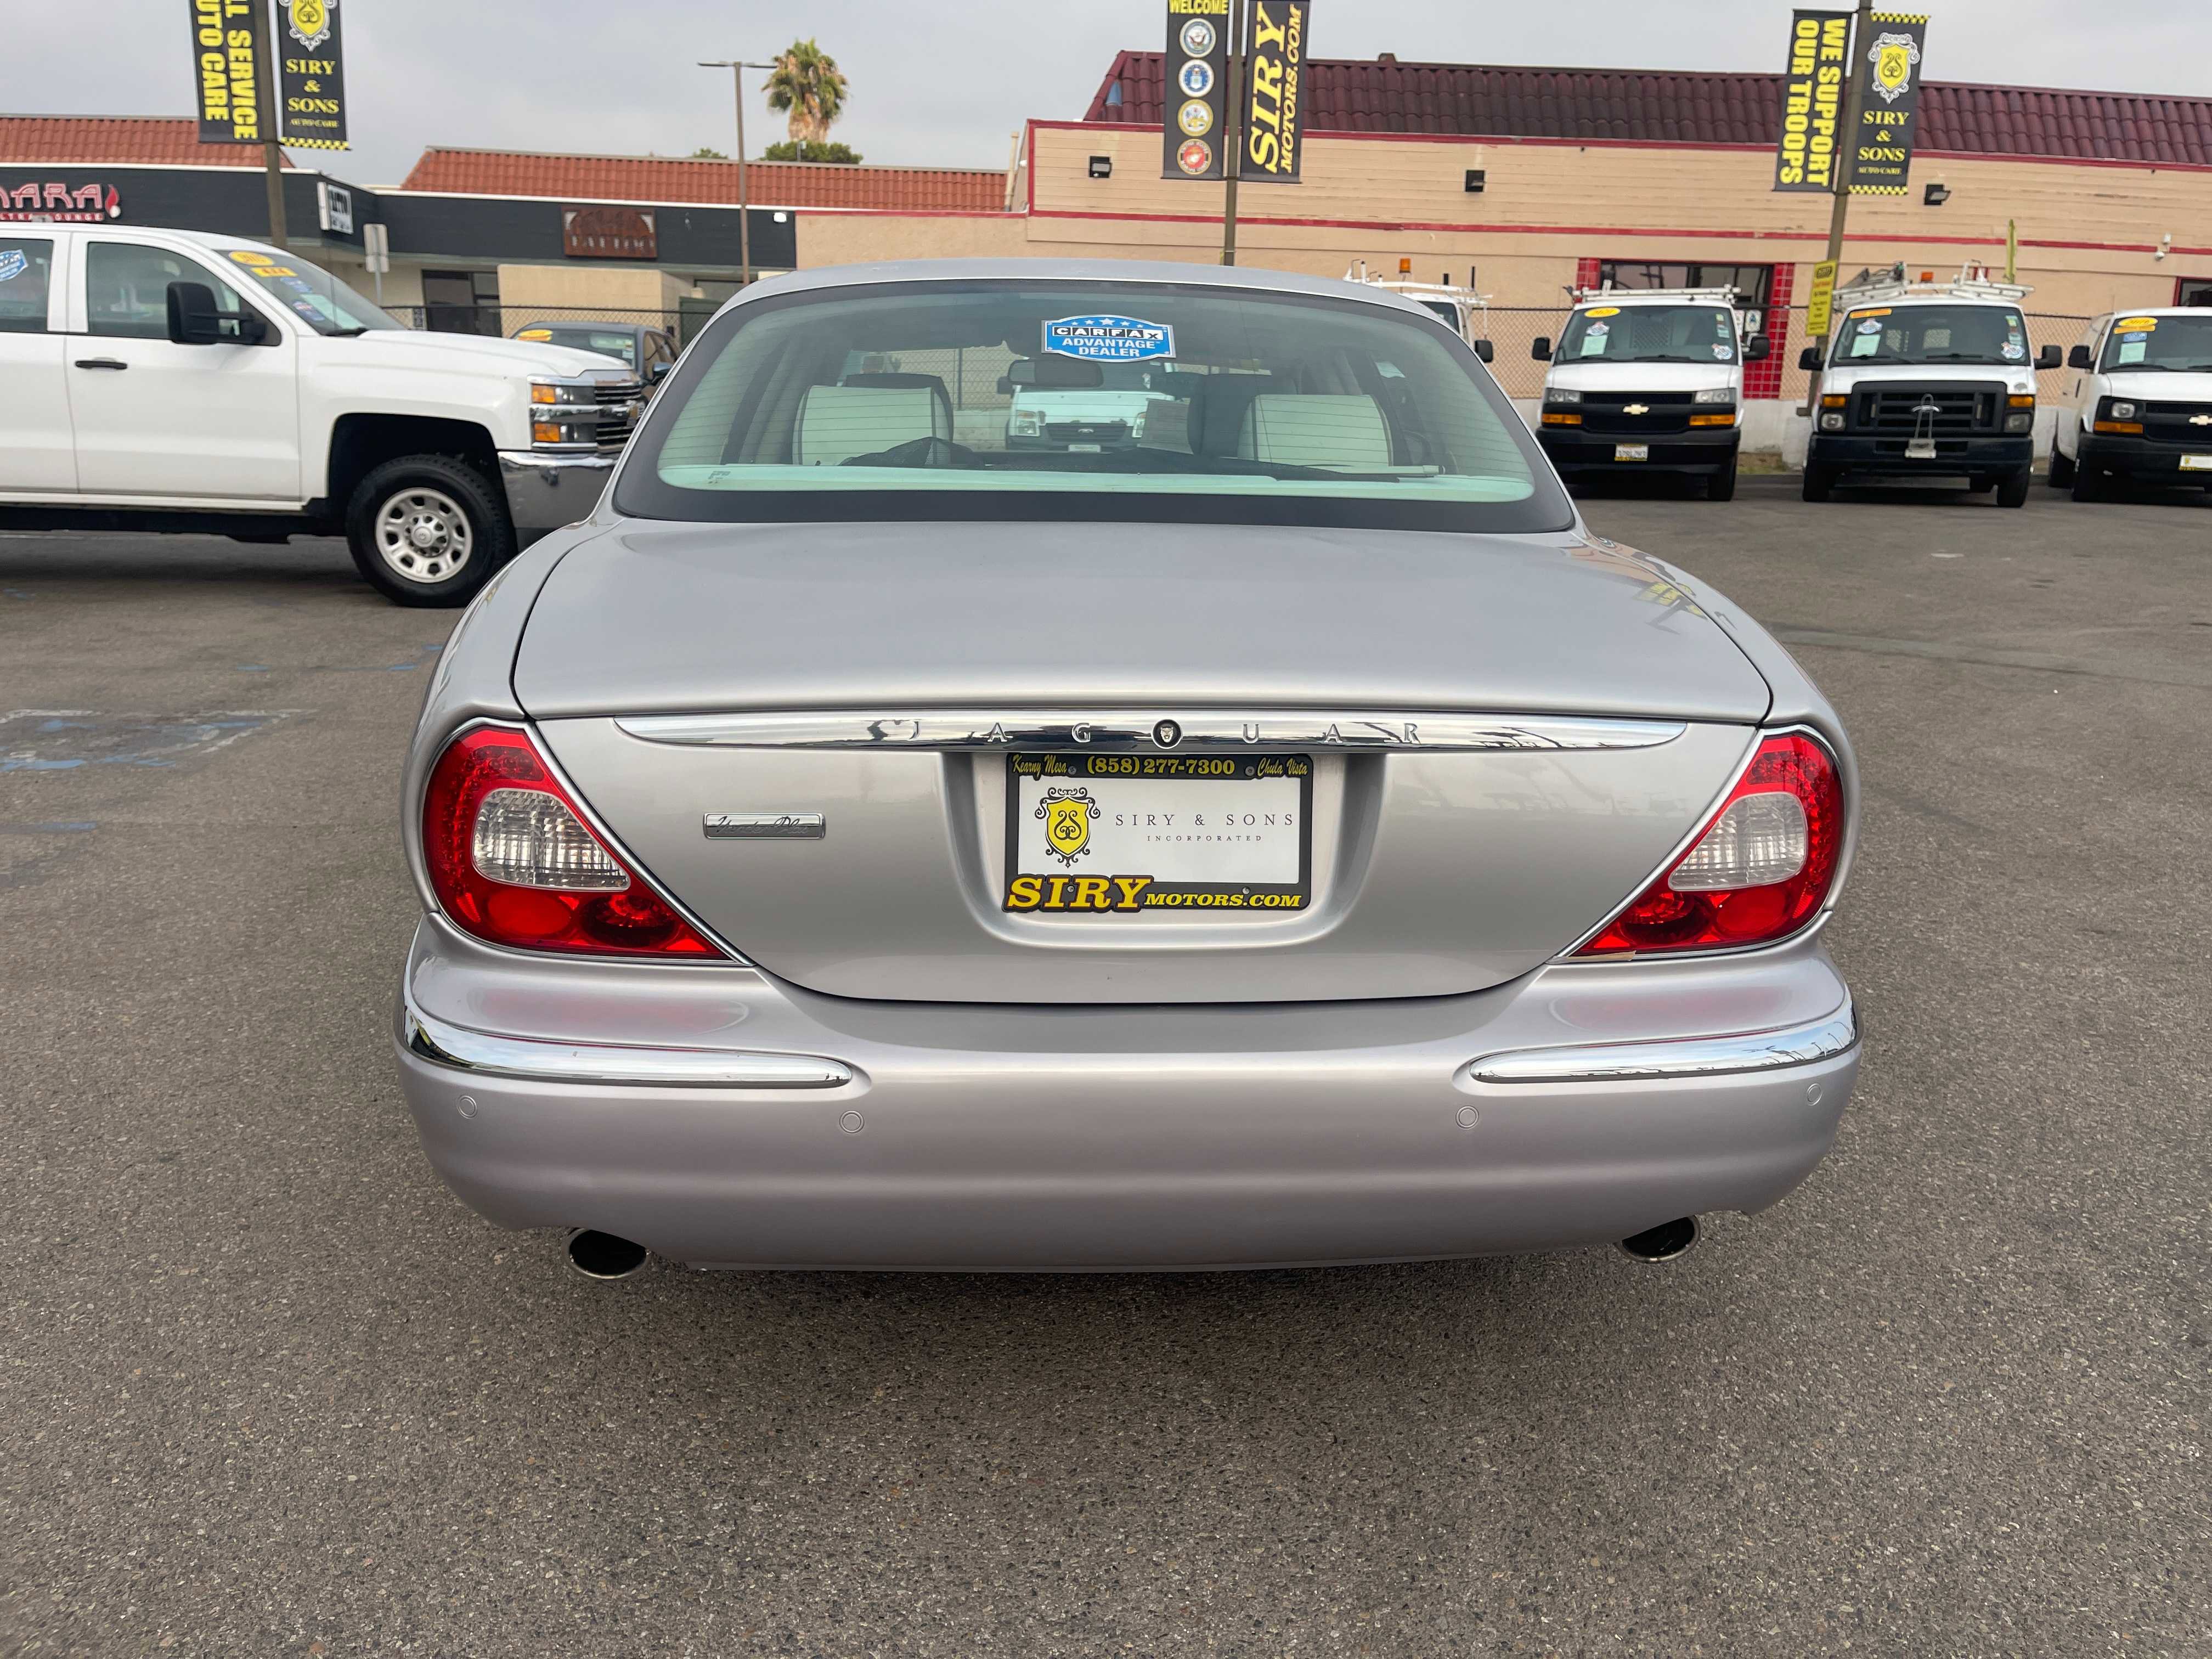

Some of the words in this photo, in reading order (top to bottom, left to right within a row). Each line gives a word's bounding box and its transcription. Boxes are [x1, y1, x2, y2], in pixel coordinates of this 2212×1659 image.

[1169, 0, 1229, 14] WELCOME
[196, 0, 224, 47] UTO
[1791, 19, 1819, 75] OUR
[1820, 18, 1847, 61] WE
[286, 59, 336, 75] SIRY
[200, 52, 229, 121] CARE
[227, 30, 258, 139] SERVICE
[304, 80, 321, 93] &
[1249, 1, 1285, 173] SIRY
[1281, 4, 1302, 173] MOTORS.COM
[288, 97, 340, 114] SONS
[1807, 66, 1841, 187] SUPPORT
[1863, 110, 1909, 125] SIRY
[1780, 80, 1813, 184] TROOPS
[1876, 129, 1892, 142] &
[1858, 146, 1905, 162] SONS
[1054, 327, 1161, 340] CARFAX
[1062, 338, 1156, 349] ADVANTAGE
[1079, 347, 1140, 357] DEALER
[1013, 754, 1042, 777] Kearny
[1044, 754, 1067, 773] Mesa
[1257, 757, 1283, 777] Chula
[1287, 758, 1308, 775] Vista
[1115, 814, 1175, 826] SIRY
[1195, 814, 1205, 826] &
[1226, 814, 1293, 826] SONS
[1008, 877, 1151, 908] SIRY
[1144, 893, 1301, 907] MOTORS.COM
